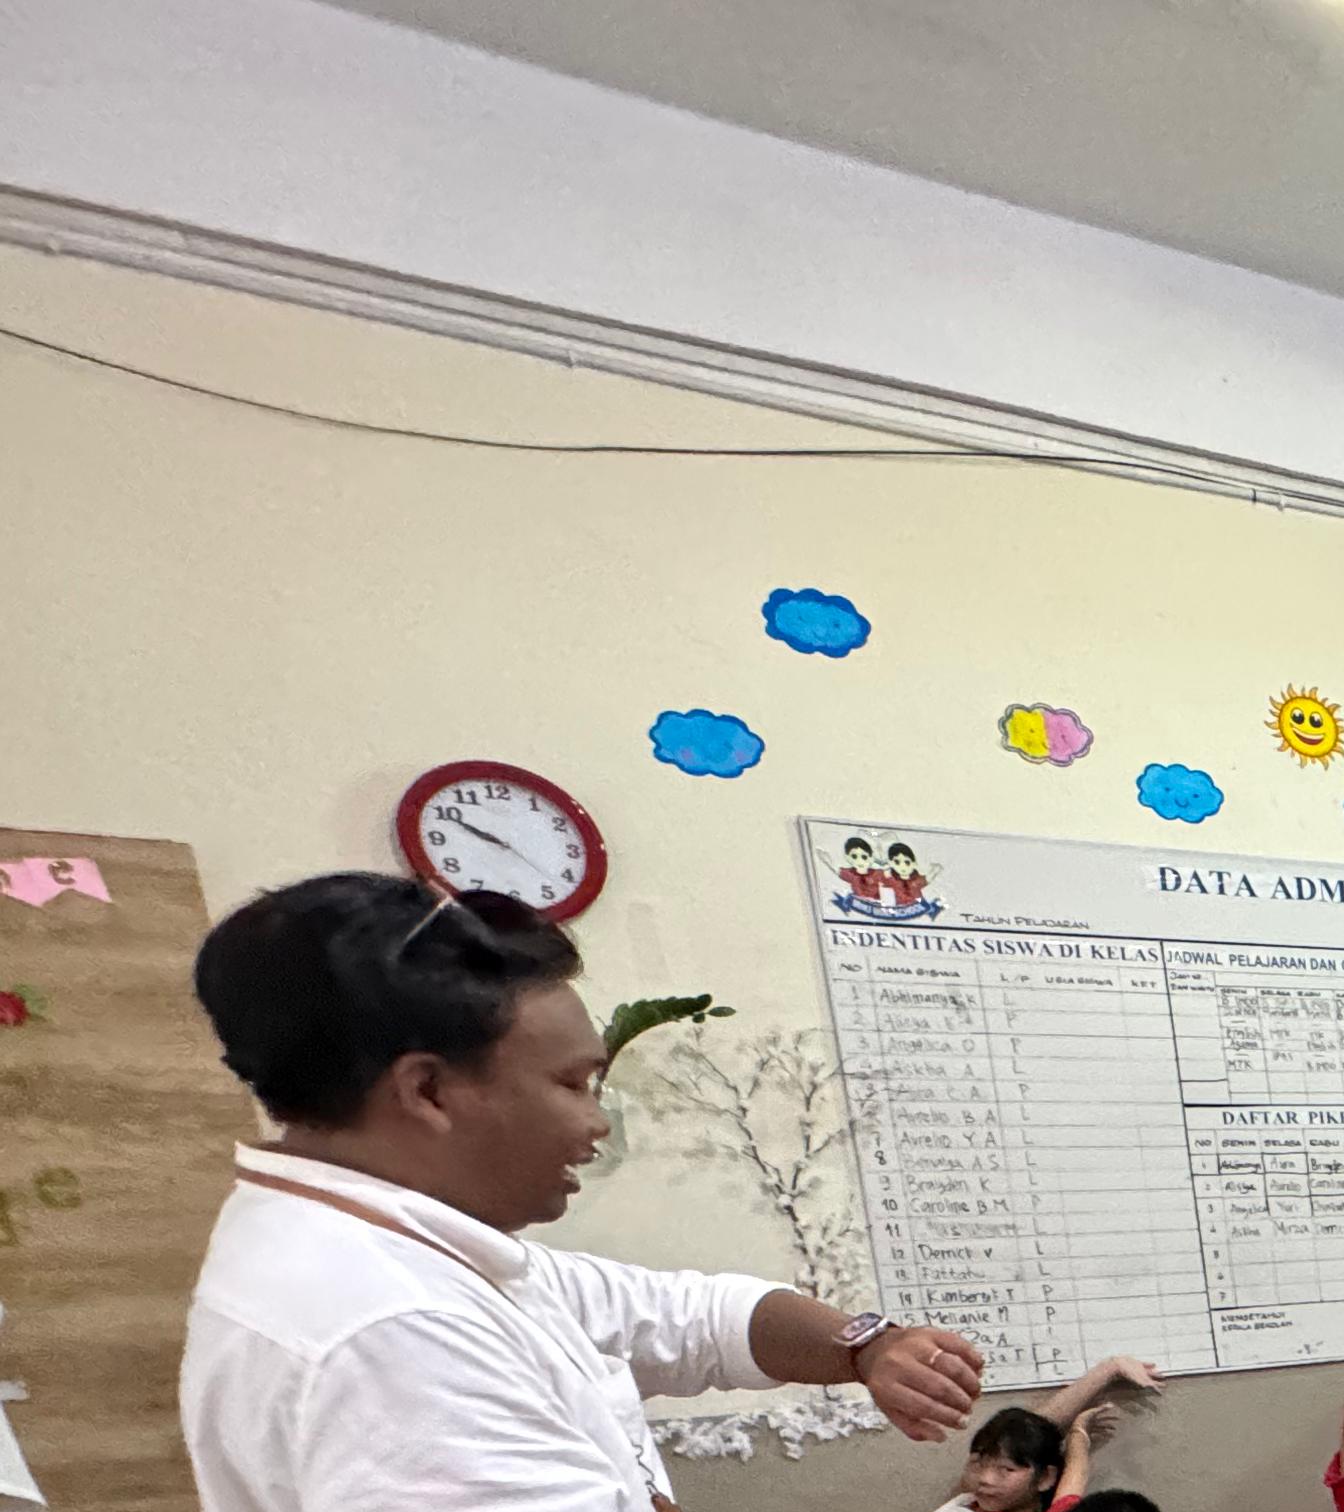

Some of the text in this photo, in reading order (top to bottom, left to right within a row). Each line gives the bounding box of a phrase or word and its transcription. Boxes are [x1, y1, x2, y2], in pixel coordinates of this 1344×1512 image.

[453, 788, 481, 806] 11
[484, 784, 511, 801] 12
[528, 796, 540, 812] 1
[434, 805, 462, 822] 10
[552, 816, 568, 835] 2
[428, 831, 446, 846] 9
[566, 843, 580, 859] 3
[442, 857, 461, 873] 8
[561, 868, 575, 883] 4
[1158, 865, 1257, 898] DATA
[541, 885, 555, 900] 5
[960, 912, 1090, 930] TAHUN PELAJARAN
[831, 930, 1159, 962] INDENTITAS SISWA DI KELAS
[1167, 950, 1223, 966] JADWAL
[1229, 954, 1307, 970] PELAJARAN
[1310, 958, 1336, 971] DAN
[1222, 1111, 1299, 1125] DAFTAR
